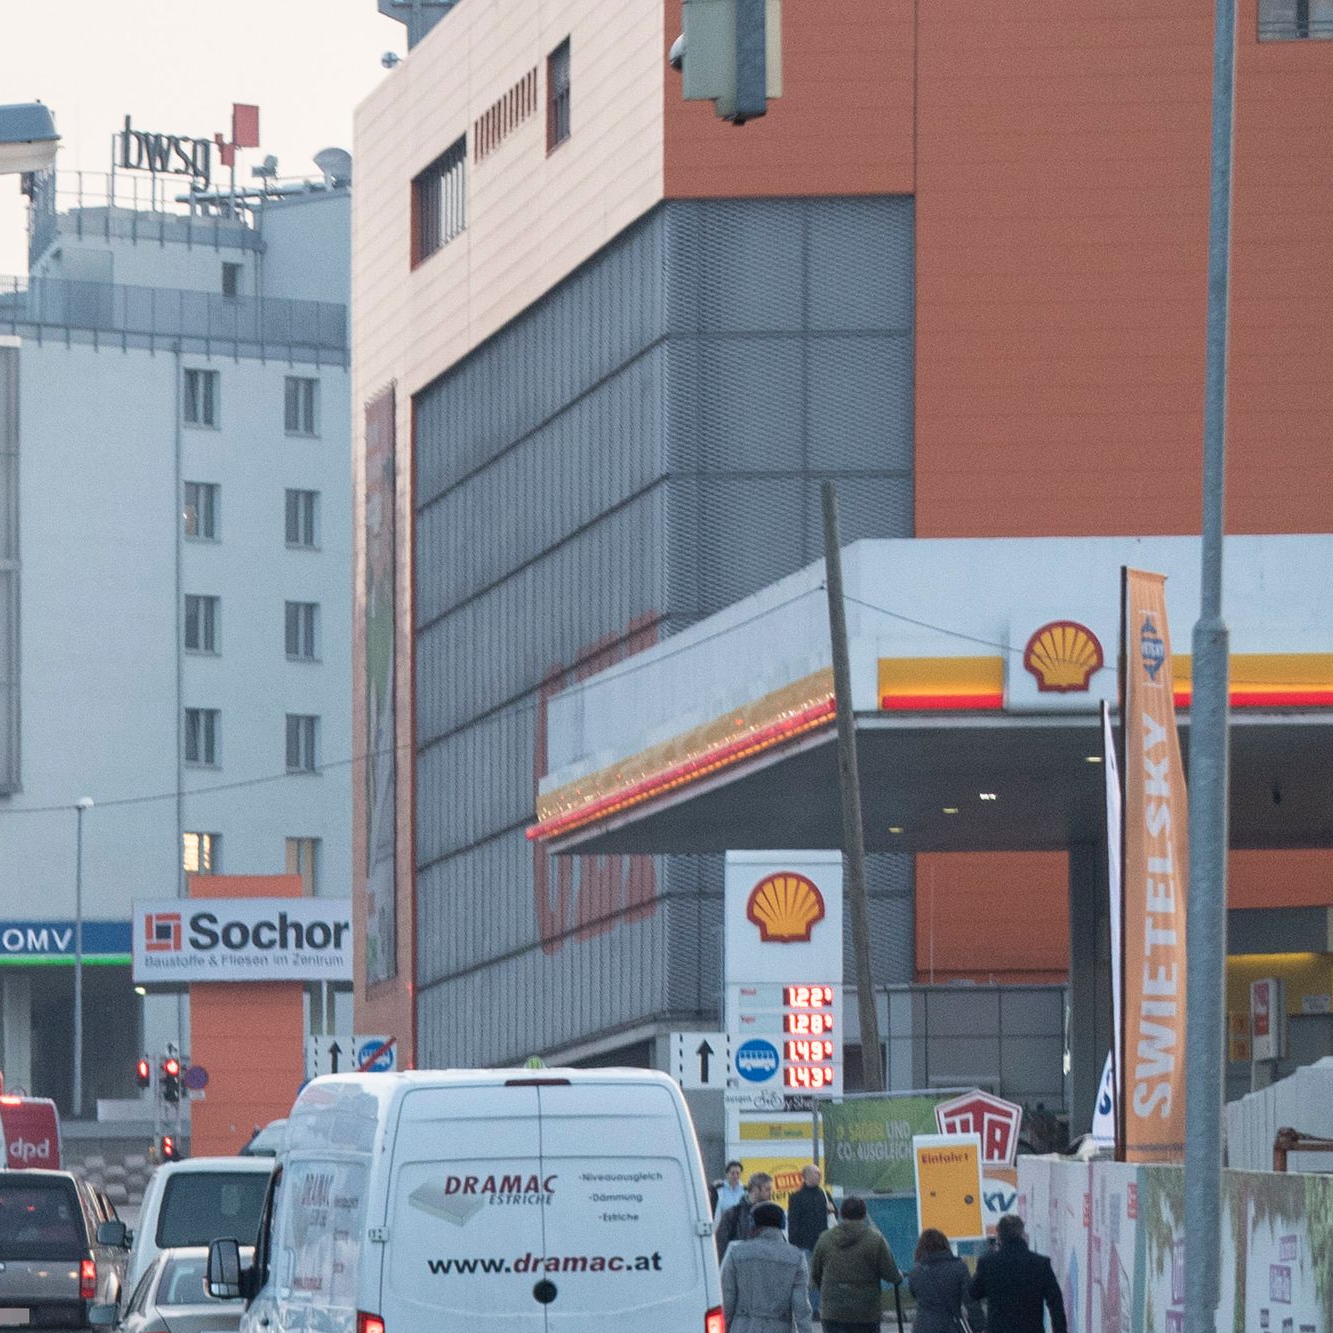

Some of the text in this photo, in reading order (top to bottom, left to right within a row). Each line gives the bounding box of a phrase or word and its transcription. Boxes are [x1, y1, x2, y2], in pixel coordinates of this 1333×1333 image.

[1133, 712, 1179, 1119] SWIETELSKY
[2, 928, 73, 952] OMV
[189, 911, 350, 951] Sochor
[144, 954, 205, 968] Baustoffe
[208, 955, 218, 966] &
[221, 953, 269, 967] Fliesen
[292, 953, 344, 968] Zentrum
[9, 1137, 50, 1162] dpd
[921, 1151, 970, 1165] Einfahrt
[444, 1174, 559, 1195] DRAMAC
[489, 1194, 552, 1206] ESTRICHE
[427, 1251, 663, 1275] www.dramac.at
